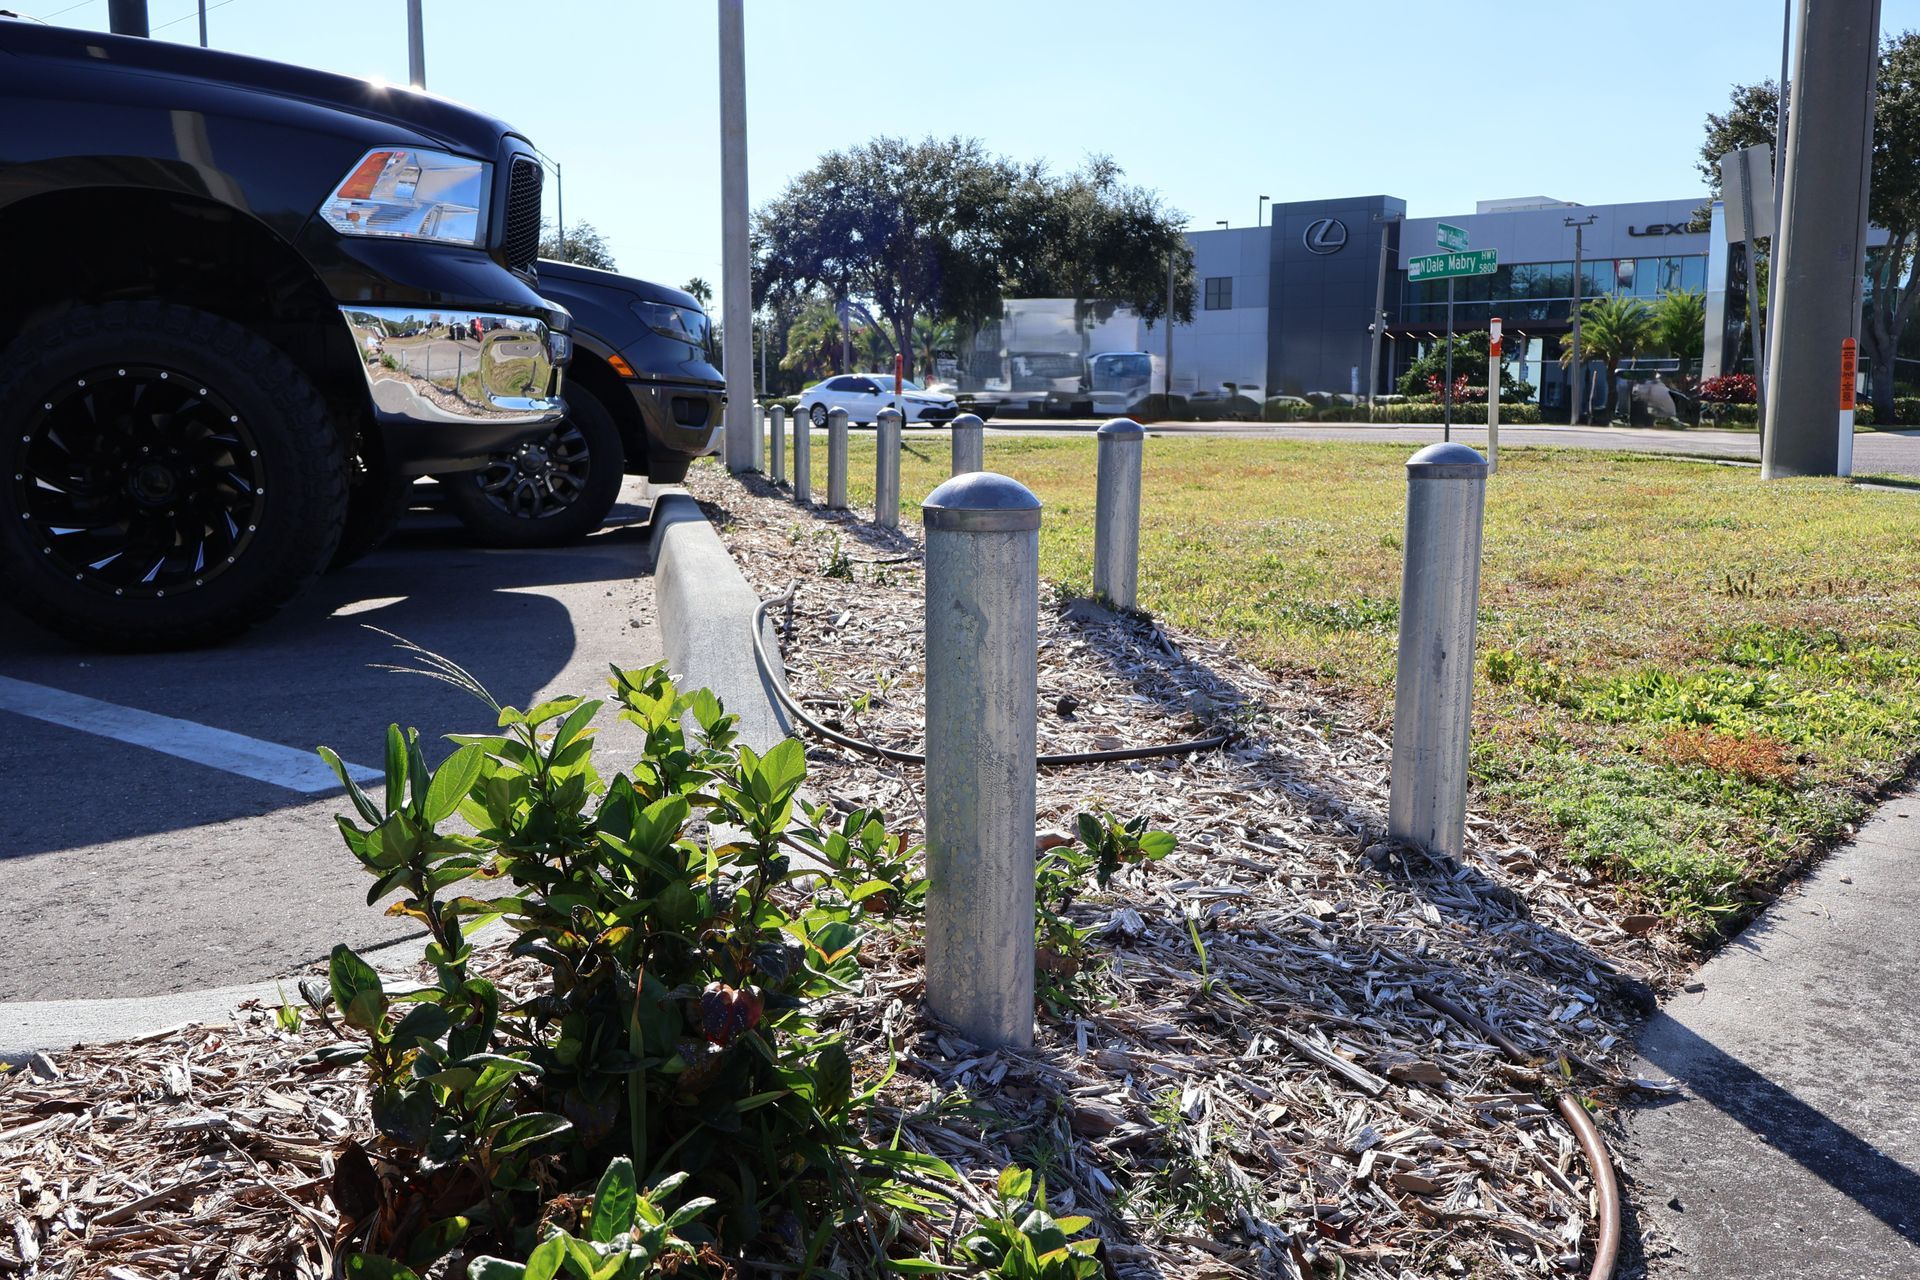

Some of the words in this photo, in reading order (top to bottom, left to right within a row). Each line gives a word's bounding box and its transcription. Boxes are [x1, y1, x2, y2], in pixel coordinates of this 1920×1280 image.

[1481, 250, 1496, 260] HWY
[1420, 259, 1426, 273] N
[1426, 257, 1444, 273] Dale
[1448, 254, 1476, 273] Mabry
